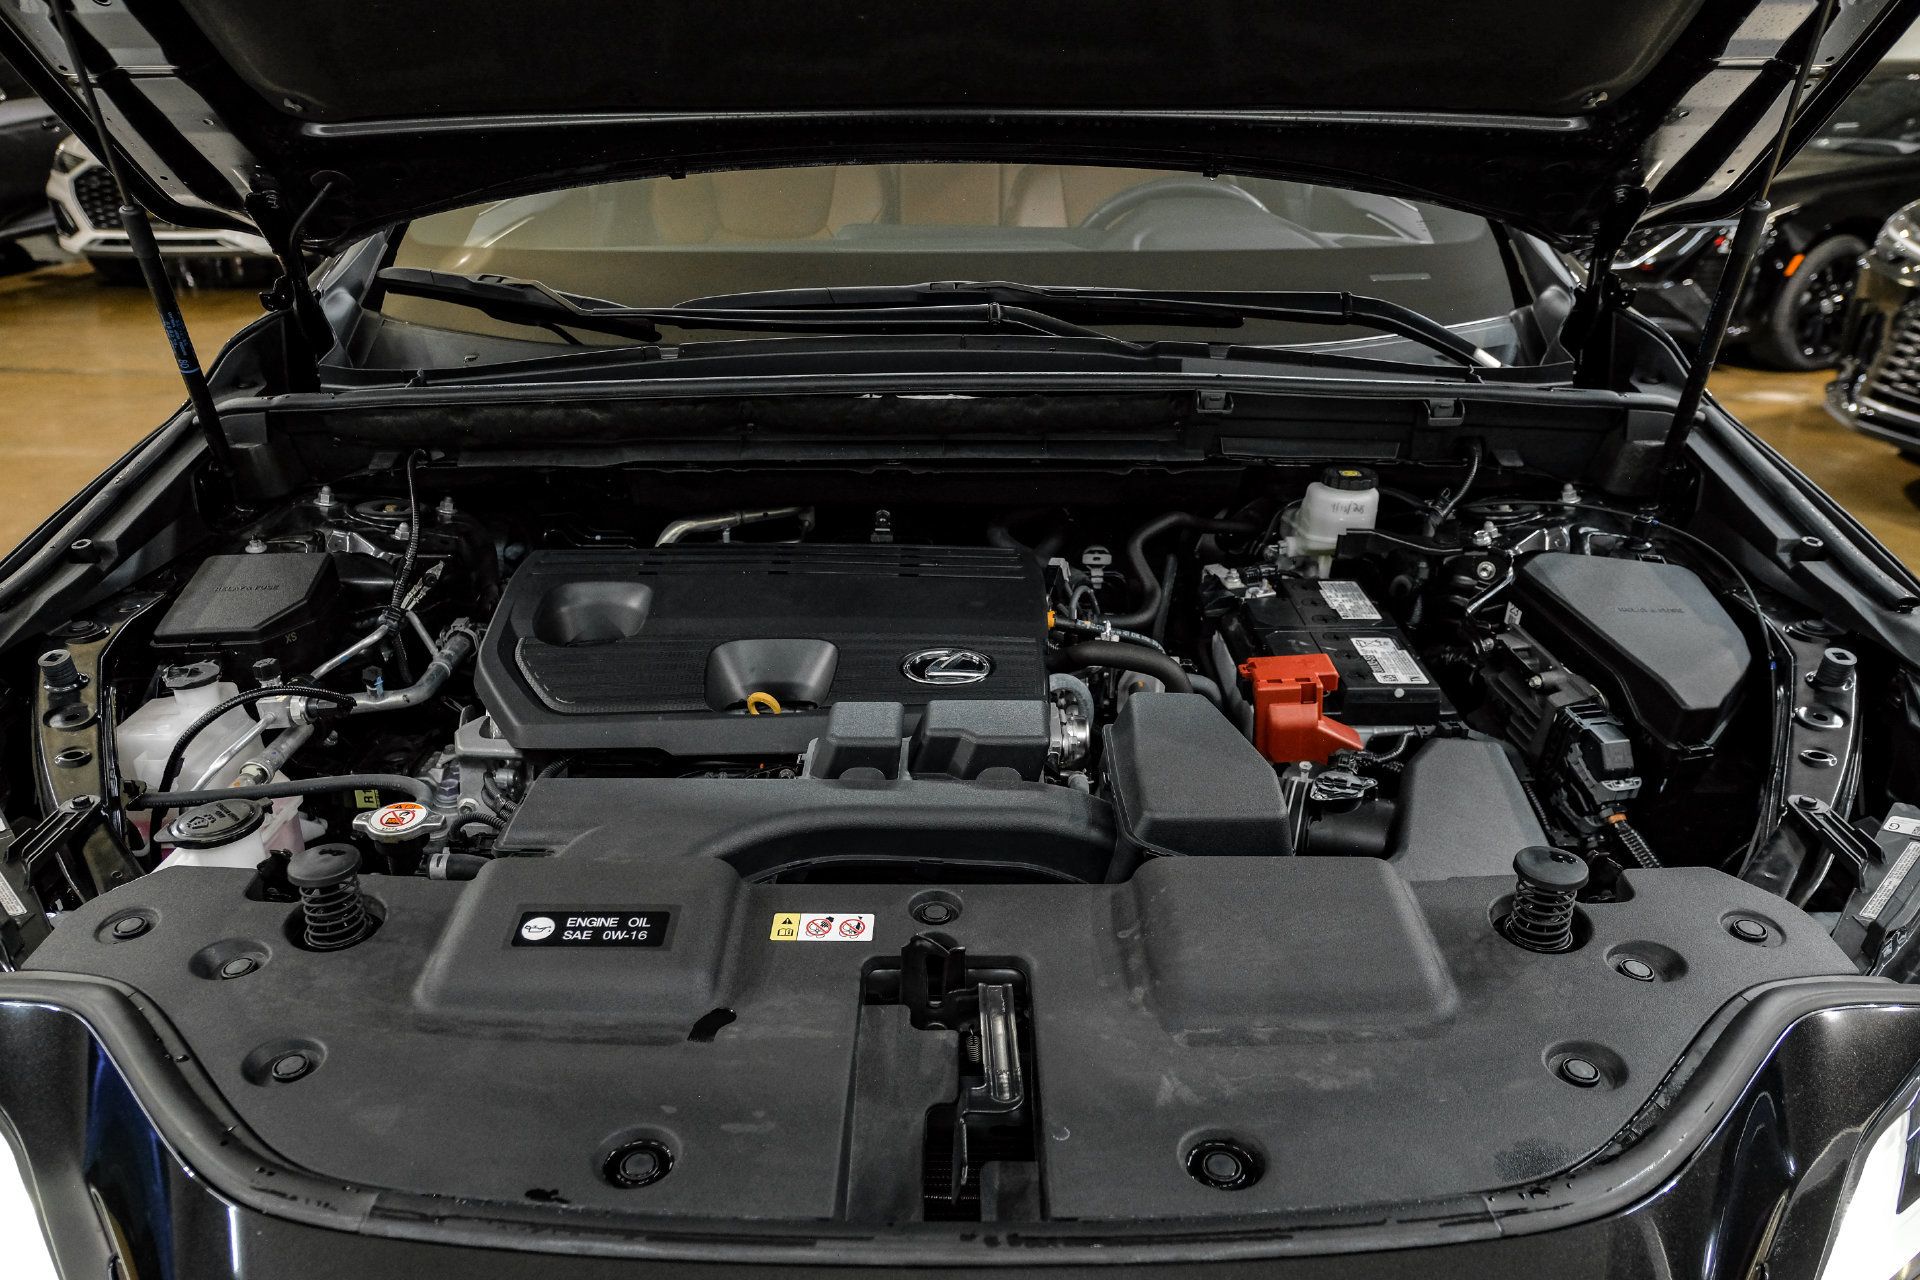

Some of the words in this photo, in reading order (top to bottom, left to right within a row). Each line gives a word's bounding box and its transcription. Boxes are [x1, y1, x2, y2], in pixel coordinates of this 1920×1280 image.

[566, 917, 620, 928] ENGINE
[628, 917, 651, 928] OIL
[562, 930, 594, 940] SAE
[602, 930, 649, 940] 0W-16
